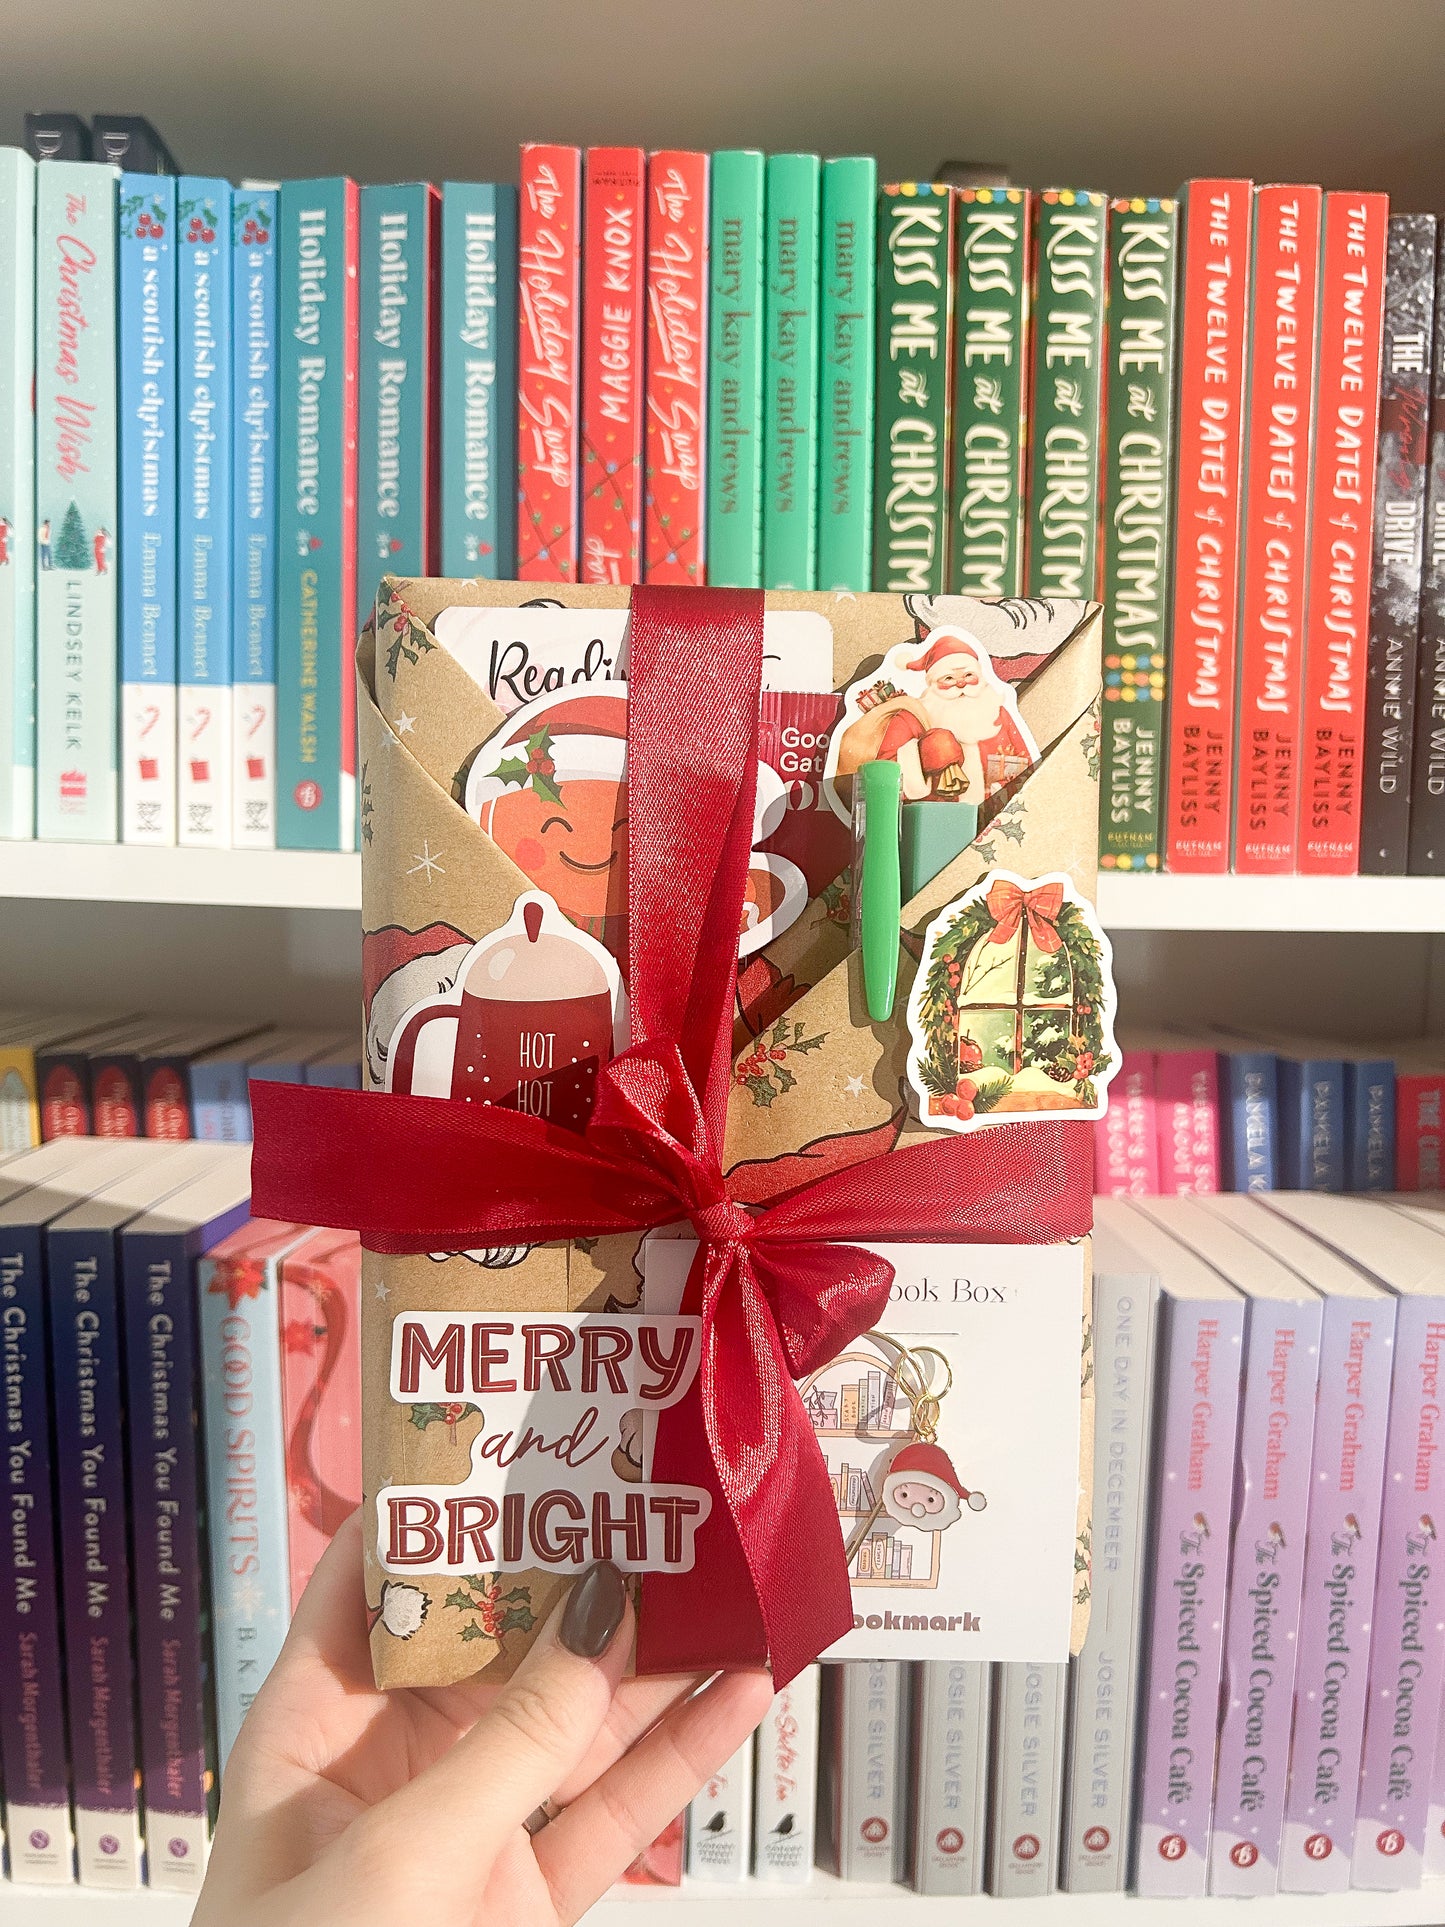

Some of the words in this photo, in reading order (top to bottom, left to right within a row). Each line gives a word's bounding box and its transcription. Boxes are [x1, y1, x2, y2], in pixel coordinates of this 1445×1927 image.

[66, 193, 87, 225] The
[528, 164, 563, 220] The
[656, 168, 690, 222] The
[1209, 192, 1230, 247] THE
[1279, 200, 1299, 254] THE
[1348, 204, 1366, 258] THE
[294, 209, 326, 346] Holiday
[373, 213, 408, 350] Holiday
[460, 213, 497, 350] Holiday
[604, 207, 634, 292] KNOX
[715, 218, 741, 302] mary
[771, 218, 797, 302] mary
[829, 220, 854, 304] mary
[889, 206, 942, 289] KISS
[964, 213, 1017, 296] KISS
[1046, 214, 1099, 299] KISS
[1118, 223, 1171, 304] KISS
[55, 234, 97, 385] Christmas
[142, 268, 165, 376] scottish
[193, 273, 216, 379] scottish
[248, 274, 270, 379] scottish
[520, 229, 571, 386] Holiday
[649, 234, 699, 387] Holiday
[715, 311, 752, 368] kay
[771, 310, 807, 368] kay
[829, 312, 864, 370] kay
[891, 303, 939, 361] ME
[965, 309, 1013, 367] ME
[1046, 311, 1094, 369] ME
[1118, 318, 1166, 376] ME
[1205, 256, 1231, 384] TWELVE
[1274, 262, 1300, 390] TWELVE
[1342, 265, 1368, 392] TWELVE
[600, 304, 632, 423] MAGGIE
[899, 369, 929, 408] at
[1391, 332, 1425, 374] THE
[296, 356, 326, 515] Romance
[973, 375, 1002, 414] at
[1054, 378, 1084, 417] at
[1127, 383, 1157, 422] at
[54, 395, 96, 484] Wish
[137, 381, 165, 517] christmas
[188, 385, 216, 519] christmas
[243, 385, 270, 518] christmas
[377, 360, 407, 519] Romance
[464, 360, 497, 520] Romance
[519, 391, 572, 488] Swap
[648, 394, 699, 490] Swap
[719, 378, 751, 515] andrews
[776, 377, 806, 514] andrews
[833, 378, 863, 515] andrews
[1198, 398, 1228, 499] DATES
[1268, 404, 1297, 504] DATES
[1333, 405, 1365, 504] DATES
[885, 418, 939, 592] CHRISTM
[960, 425, 1013, 595] CHRISTM
[1038, 425, 1090, 598] CHRISTM
[1113, 431, 1163, 649] CHRISTMAS
[1383, 500, 1417, 566] DRIVE
[142, 532, 161, 598] Emma
[192, 534, 212, 600] Emma
[248, 533, 267, 598] Emma
[66, 580, 82, 683] LINDSEY
[142, 603, 161, 677] Bennet
[192, 605, 212, 678] Bennet
[300, 569, 320, 689] CATHERINE
[1187, 534, 1224, 710] CHRISTMAS
[1257, 540, 1293, 715] CHRISTMAS
[1320, 541, 1357, 713] CHRISTMAS
[488, 639, 630, 705] Readi
[1383, 636, 1403, 718] ANNIE
[65, 692, 82, 750] KELK
[299, 695, 318, 763] WALSH
[780, 751, 828, 773] Gat
[781, 727, 830, 748] Goo
[1380, 725, 1402, 793] WILD
[1427, 727, 1445, 795] WILD
[1111, 718, 1133, 823] BAYLISS
[1135, 727, 1154, 813] JENNY
[1181, 725, 1200, 828] BAYLISS
[1204, 730, 1223, 813] JENNY
[1250, 728, 1269, 830] BAYLISS
[1273, 732, 1292, 817] JENNY
[1312, 727, 1332, 830] BAYLISS
[1338, 731, 1356, 816] JENNY
[520, 1032, 556, 1068] HOT
[517, 1080, 553, 1116] HOT
[0, 1252, 24, 1299] The
[74, 1256, 98, 1303] The
[149, 1260, 172, 1307] The
[888, 1277, 940, 1303] ook
[952, 1278, 1008, 1303] Box
[399, 1322, 695, 1399] MERRY
[1115, 1296, 1132, 1347] ONE
[1191, 1319, 1219, 1396] Harper
[1344, 1321, 1372, 1398] Harper
[1419, 1322, 1445, 1398] Harper
[3, 1307, 27, 1433] Christmas
[75, 1310, 101, 1437] Christmas
[150, 1313, 174, 1440] Christmas
[221, 1315, 254, 1417] GOOD
[1113, 1357, 1131, 1403] DAY
[1267, 1329, 1296, 1405] Harper
[8, 1440, 32, 1484] You
[480, 1406, 609, 1469] and
[1110, 1410, 1126, 1433] IN
[1187, 1402, 1213, 1491] Graham
[1263, 1411, 1290, 1500] Graham
[1339, 1403, 1365, 1492] Graham
[1414, 1404, 1441, 1492] Graham
[81, 1444, 105, 1489] You
[155, 1447, 178, 1491] You
[224, 1428, 259, 1575] SPIRITS
[1104, 1441, 1125, 1573] DECEMBER
[11, 1494, 37, 1568] Found
[84, 1498, 108, 1573] Found
[157, 1499, 181, 1574] Found
[385, 1488, 700, 1565] BRIGHT
[14, 1577, 38, 1615] Me
[87, 1581, 111, 1619] Me
[159, 1583, 182, 1622] Me
[851, 1610, 981, 1632] ookmark
[1174, 1562, 1205, 1653] Spiced
[1249, 1571, 1279, 1662] Spiced
[1324, 1563, 1355, 1653] Spiced
[1399, 1564, 1430, 1652] Spiced
[1096, 1651, 1115, 1721] JOSIE
[1171, 1660, 1198, 1740] Cocoa
[1245, 1669, 1273, 1749] Cocoa
[1320, 1660, 1347, 1741] Cocoa
[1392, 1659, 1424, 1738] Cocoa
[866, 1719, 887, 1801] SILVER
[943, 1727, 965, 1811] SILVER
[1021, 1736, 1042, 1815] SILVER
[1092, 1729, 1112, 1809] SILVER
